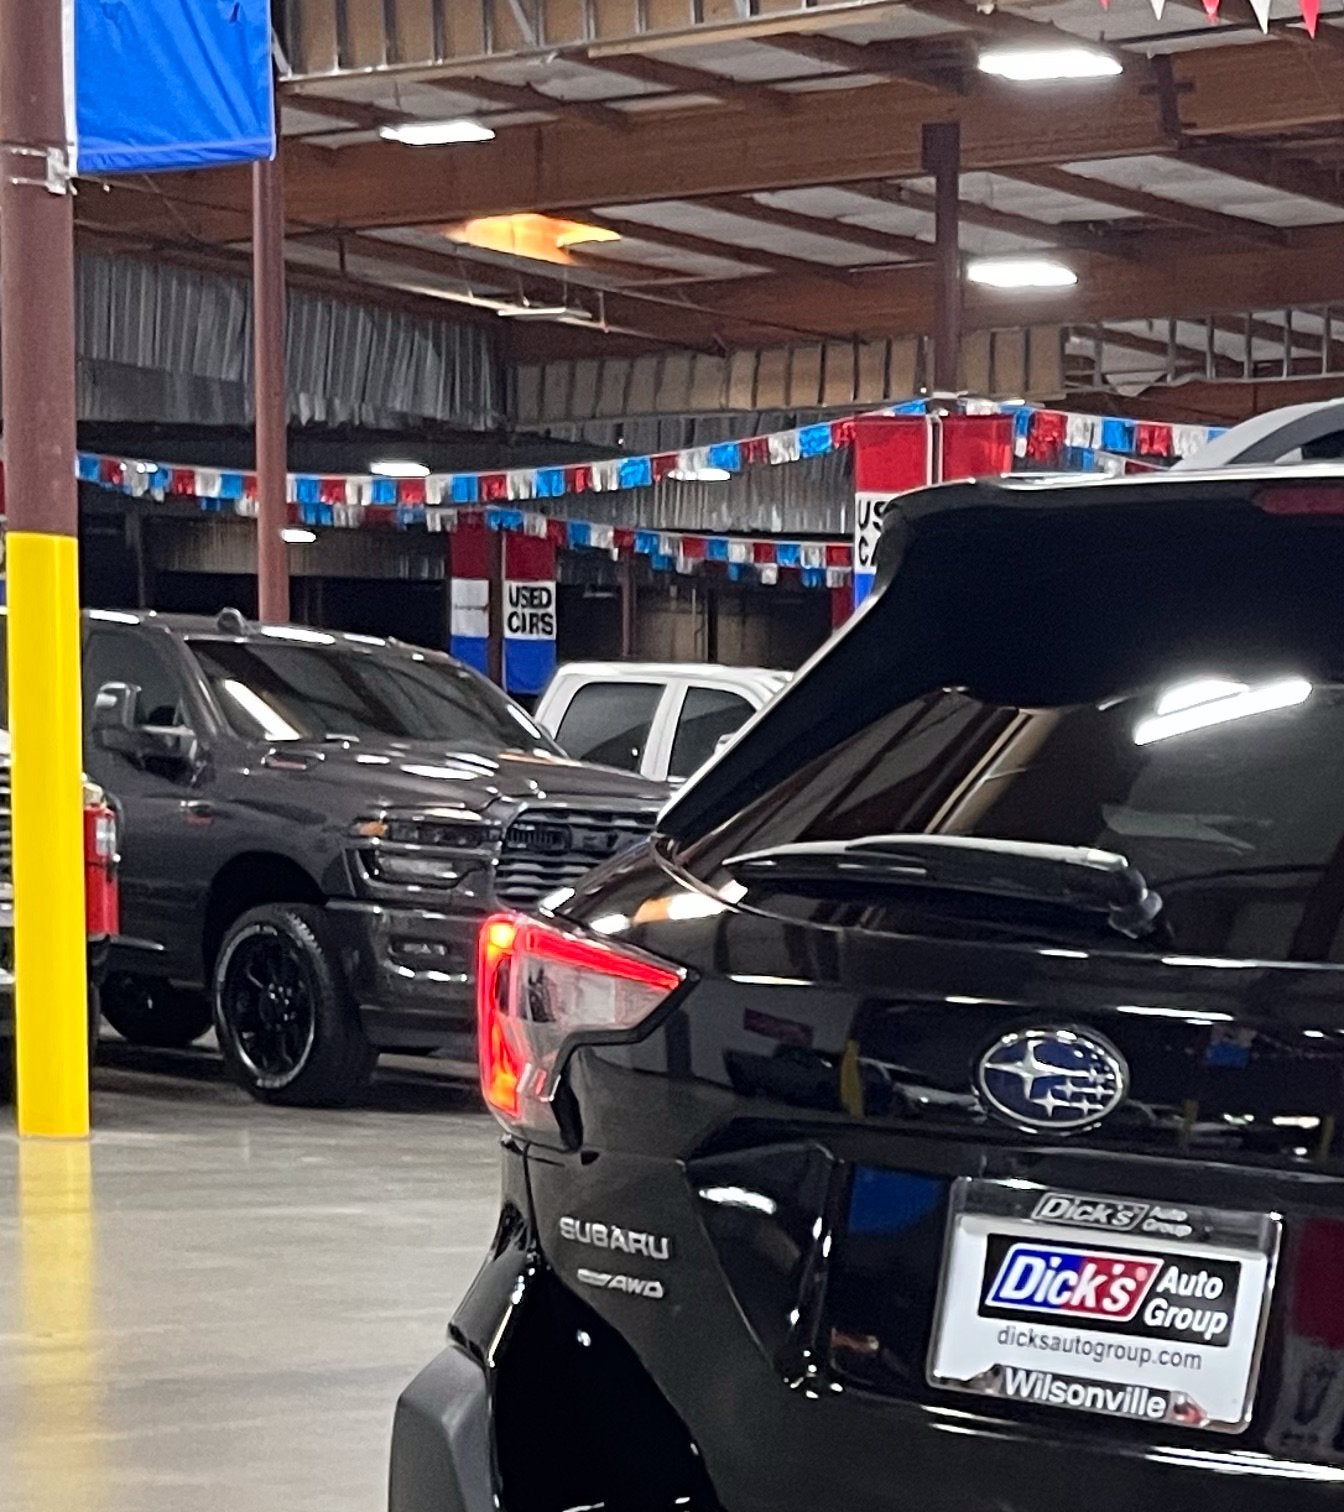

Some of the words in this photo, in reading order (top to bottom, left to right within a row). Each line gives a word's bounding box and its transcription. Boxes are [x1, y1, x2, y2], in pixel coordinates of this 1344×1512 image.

[509, 585, 553, 609] USED
[560, 1216, 669, 1260] SUBARU
[998, 1254, 1137, 1313] Dick's
[1156, 1266, 1224, 1300] Auto
[1143, 1297, 1229, 1341] Group
[997, 1325, 1202, 1370] dicksautogroup.com
[1005, 1366, 1168, 1419] Wilsonville
